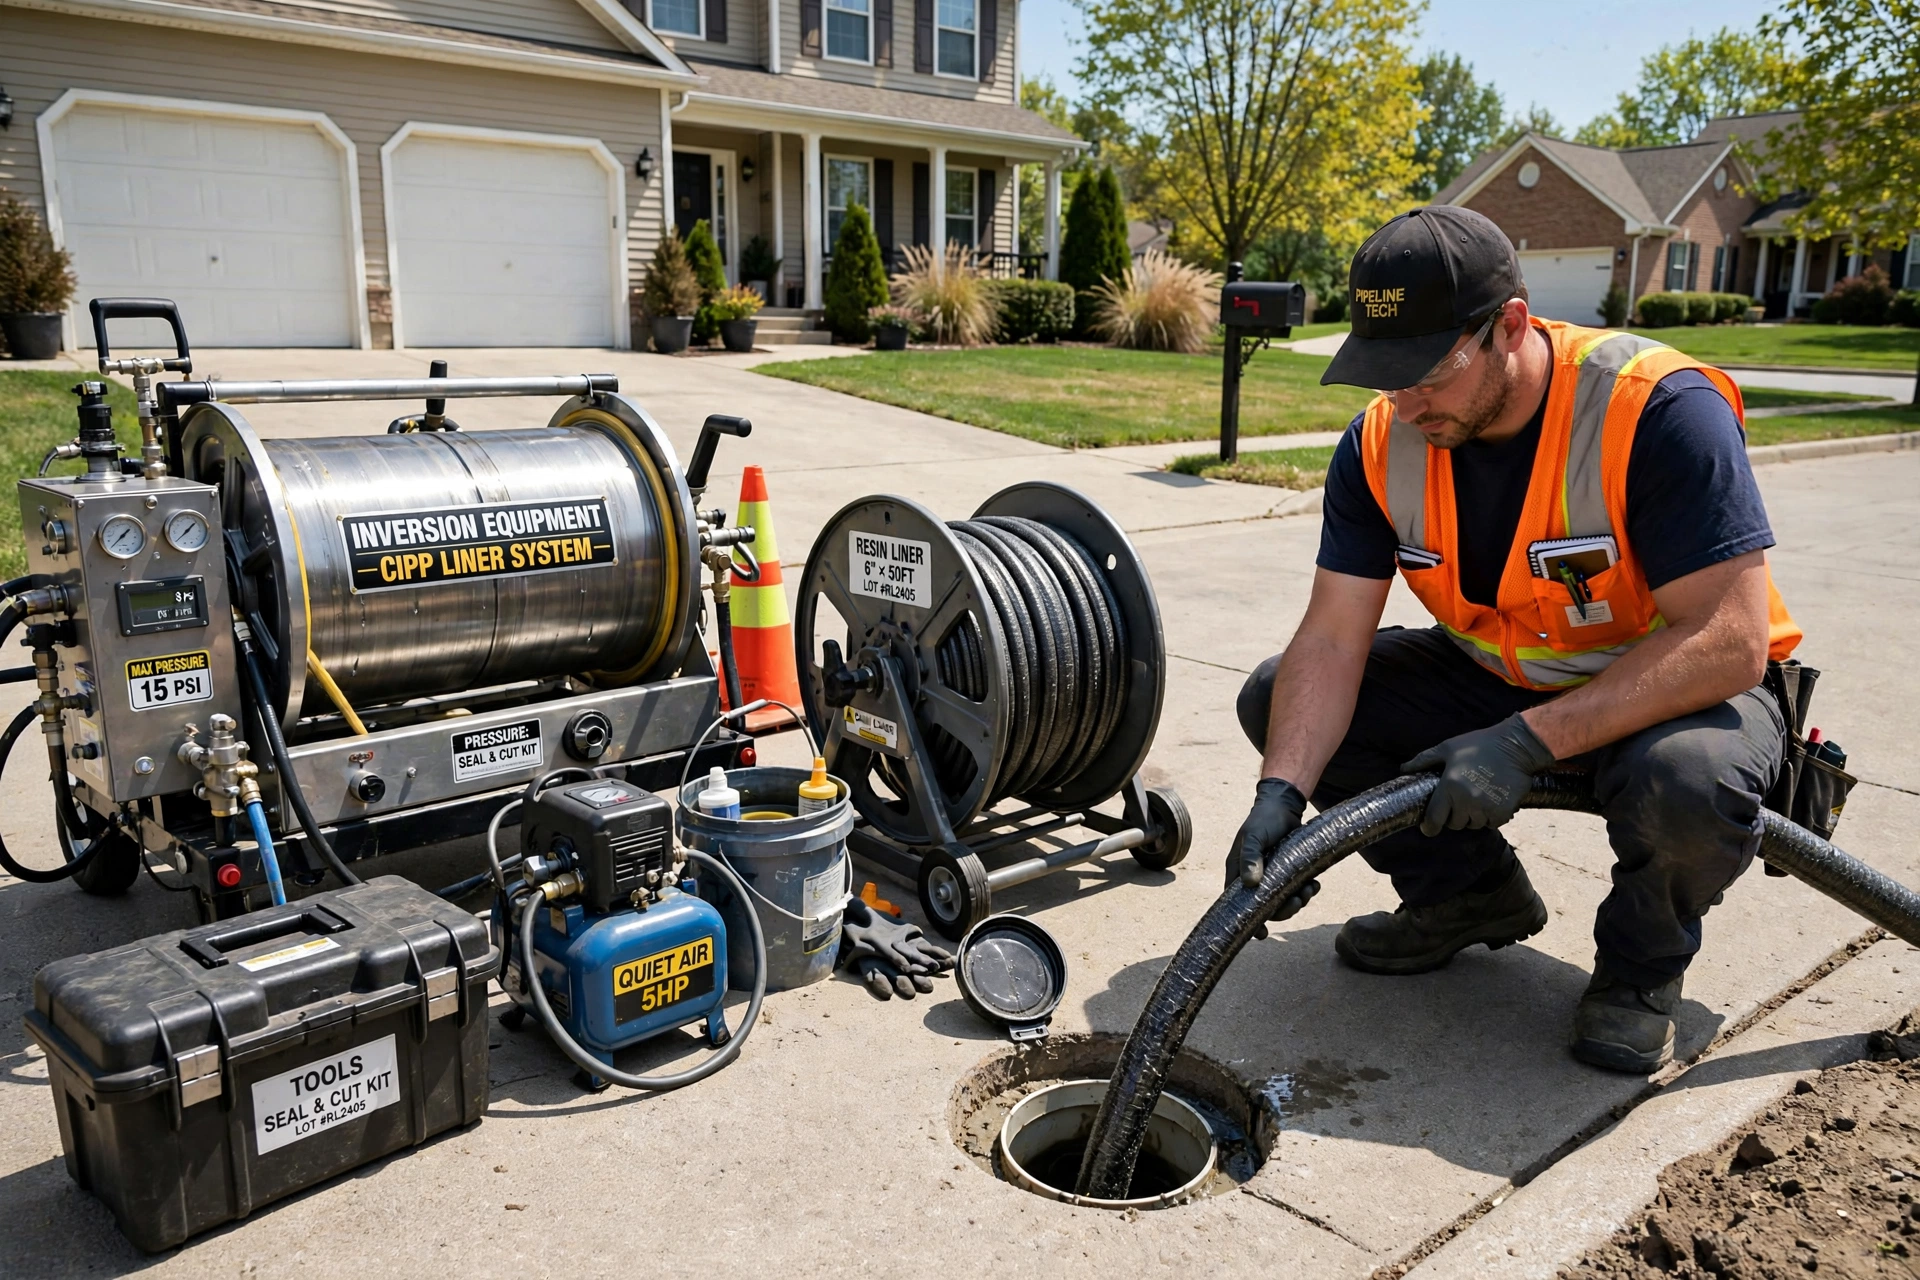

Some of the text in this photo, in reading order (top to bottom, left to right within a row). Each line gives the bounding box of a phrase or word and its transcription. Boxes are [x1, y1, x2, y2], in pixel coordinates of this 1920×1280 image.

[1355, 287, 1405, 303] PIPELINE
[1365, 303, 1398, 318] TECH
[350, 504, 601, 549] INVERSION EQUIPMENT
[380, 536, 593, 582] CIPP LINER SYSTEM
[856, 536, 924, 566] RESIN LINER
[888, 564, 915, 584] 50FT
[863, 579, 916, 602] LOT #RL2405
[131, 654, 205, 678] MAX PRESSURE
[140, 676, 202, 703] 15 PSI
[464, 725, 530, 750] PRESSURE:
[458, 753, 487, 769] SEAL
[489, 751, 497, 763] &
[499, 746, 520, 761] CUT
[521, 742, 537, 757] KIT
[618, 943, 709, 989] QUIET AIR
[641, 975, 690, 1012] 5HP
[289, 1055, 364, 1097] TOOLS
[264, 1070, 392, 1133] SEAL & CUT KIT
[295, 1099, 366, 1137] LOT #RL2405
